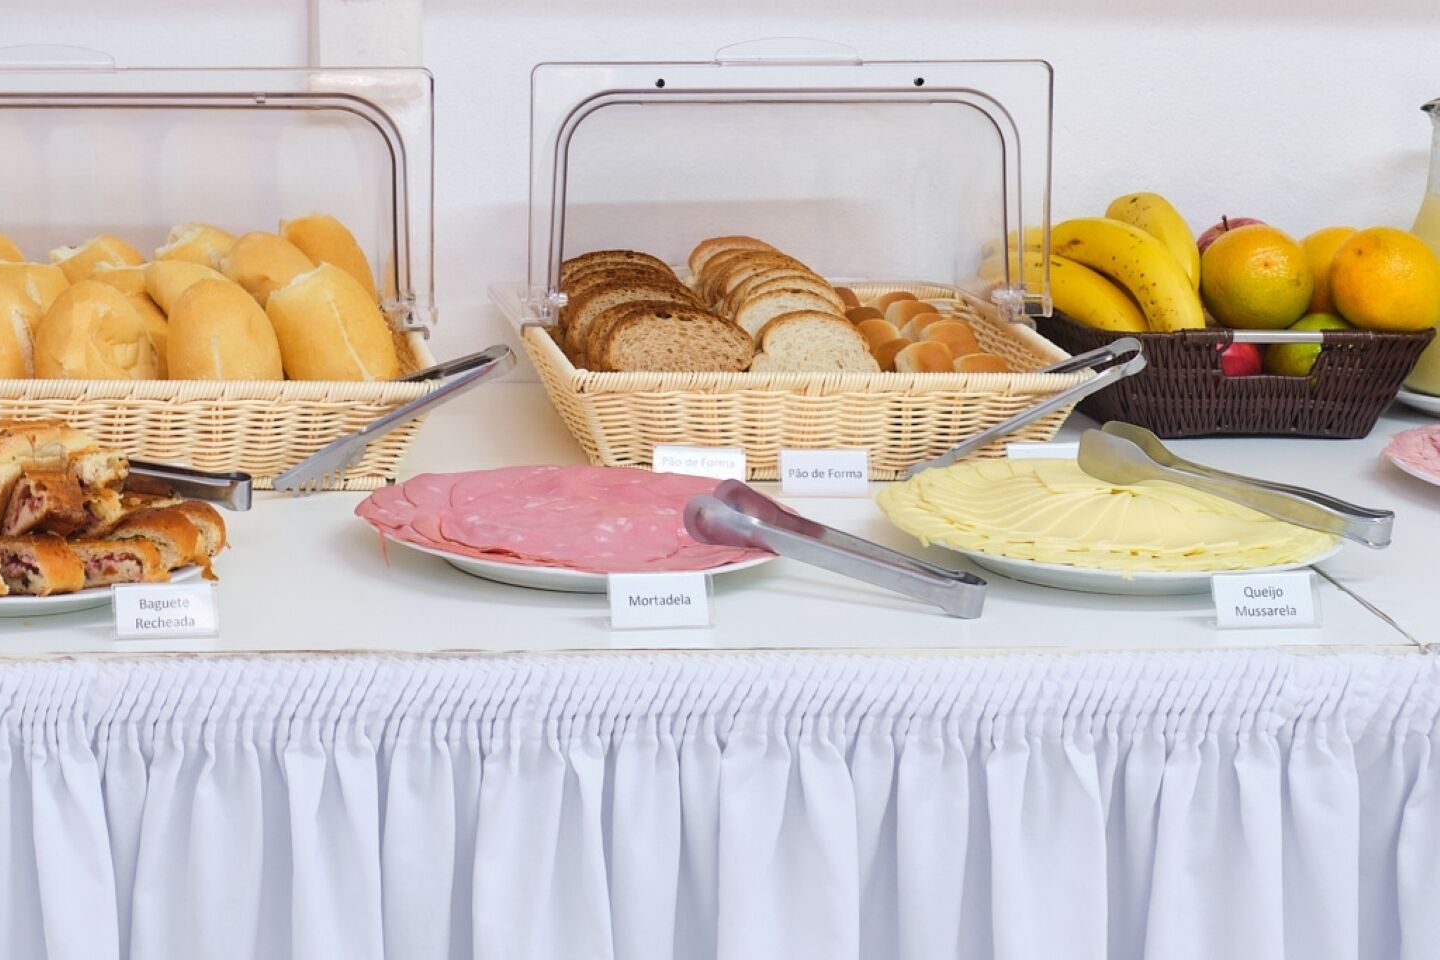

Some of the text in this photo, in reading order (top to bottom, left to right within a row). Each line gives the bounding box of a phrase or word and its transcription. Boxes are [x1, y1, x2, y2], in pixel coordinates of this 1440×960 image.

[685, 456, 698, 467] de
[701, 457, 735, 469] Forma
[789, 467, 863, 479] Pão de Forma
[1243, 586, 1284, 599] Queijo
[139, 598, 191, 611] Baguete
[629, 594, 691, 607] Mortadela
[1235, 605, 1297, 617] Mussarela
[135, 616, 195, 629] Recheada
